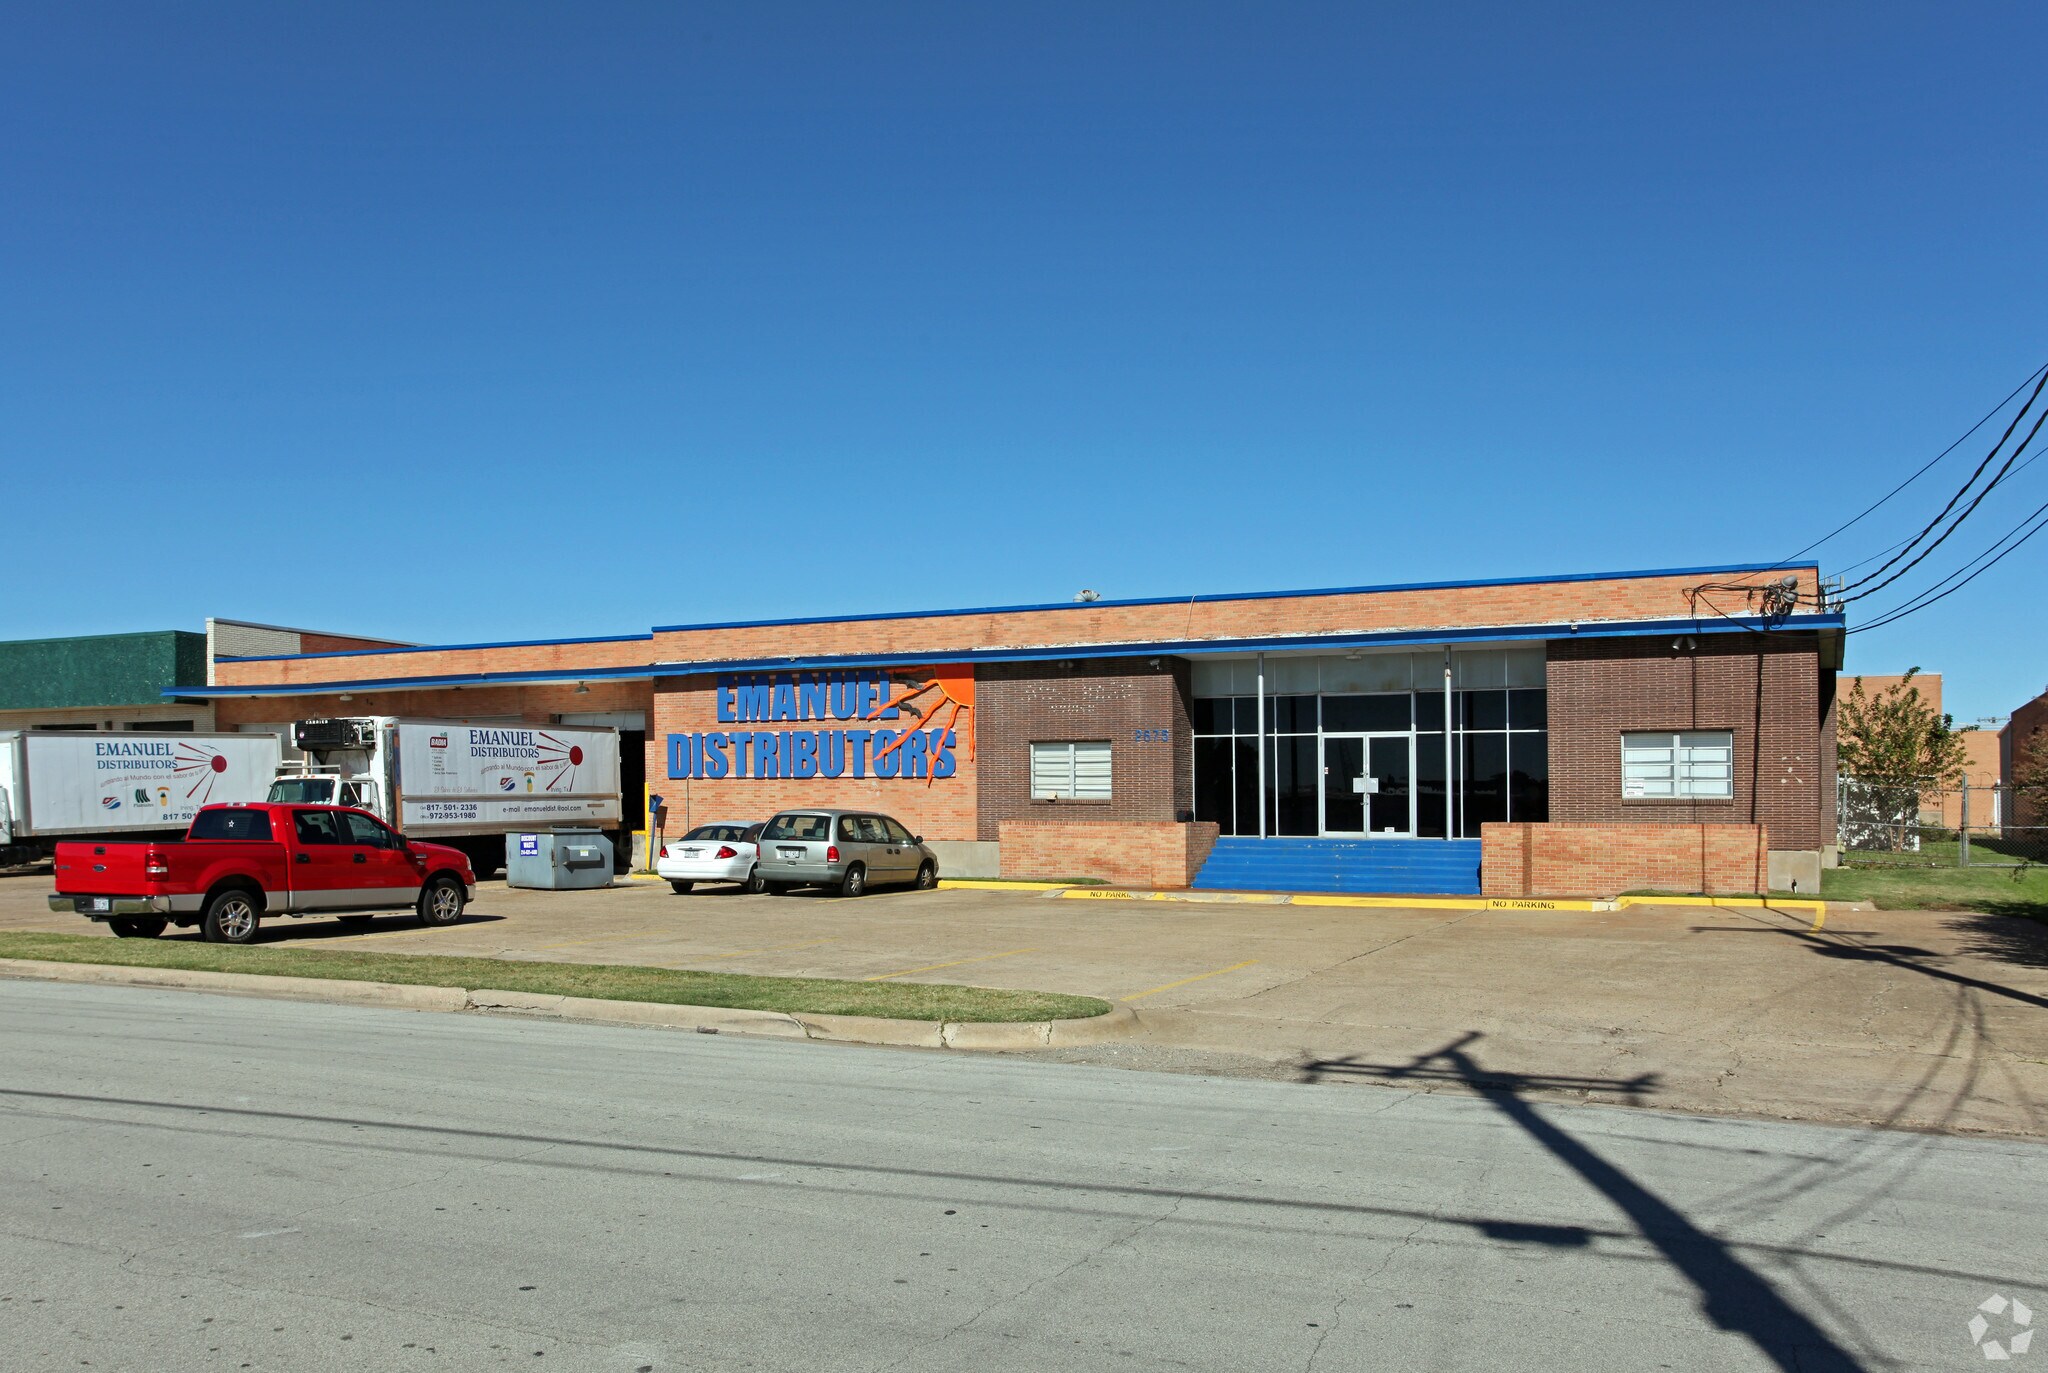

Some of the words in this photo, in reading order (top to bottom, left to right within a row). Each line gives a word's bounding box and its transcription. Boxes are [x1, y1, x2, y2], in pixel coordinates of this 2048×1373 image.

[716, 669, 899, 723] EMANUEL
[469, 730, 536, 746] EMANUEL
[1136, 730, 1168, 742] 2675
[96, 742, 174, 756] EMANUEL
[471, 747, 540, 758] DISTRIBUTORS
[667, 727, 957, 780] DISTRIBUTORS
[97, 760, 178, 770] DISTRIBUTORS
[1512, 901, 1555, 909] PARKING
